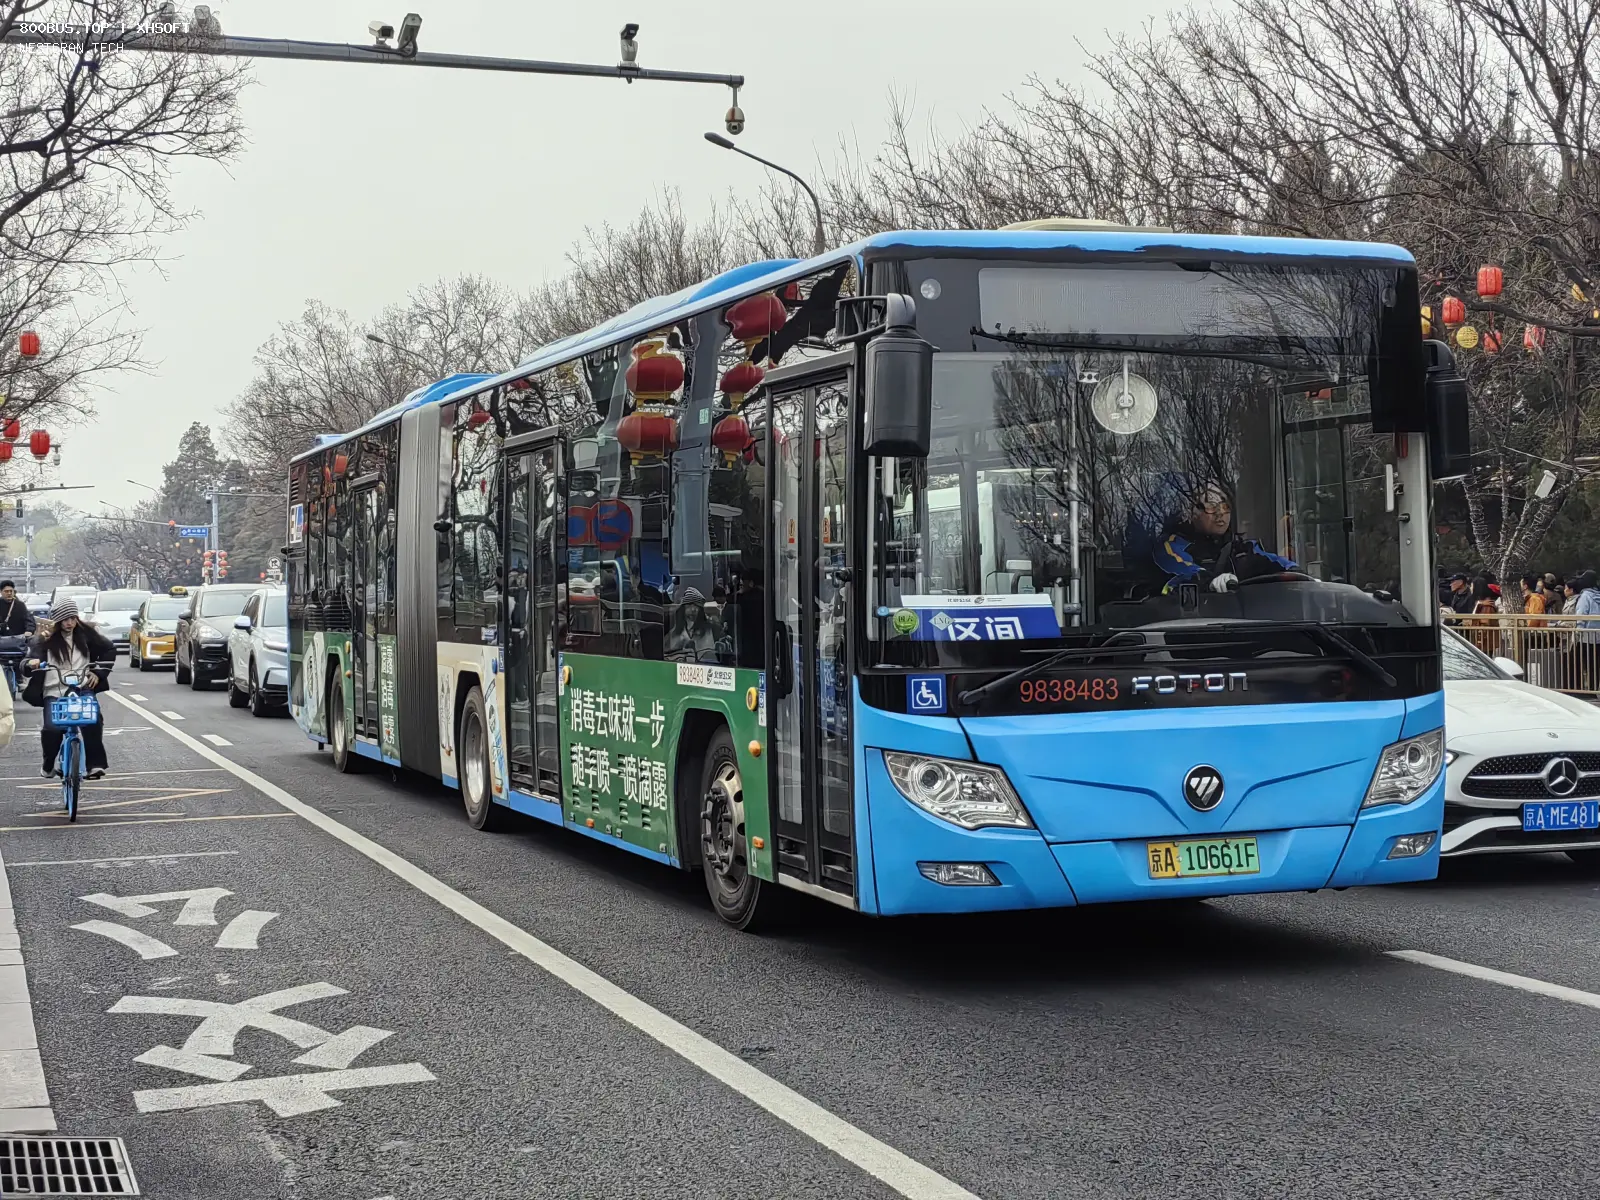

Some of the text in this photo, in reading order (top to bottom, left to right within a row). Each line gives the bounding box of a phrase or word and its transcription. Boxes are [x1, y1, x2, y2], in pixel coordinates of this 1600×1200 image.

[947, 616, 1025, 641] 区间
[679, 665, 704, 685] 9838483
[1019, 678, 1119, 703] 9838483
[570, 687, 665, 749] 消毒去味就一步
[570, 742, 668, 811] 随手喷一喷滴露
